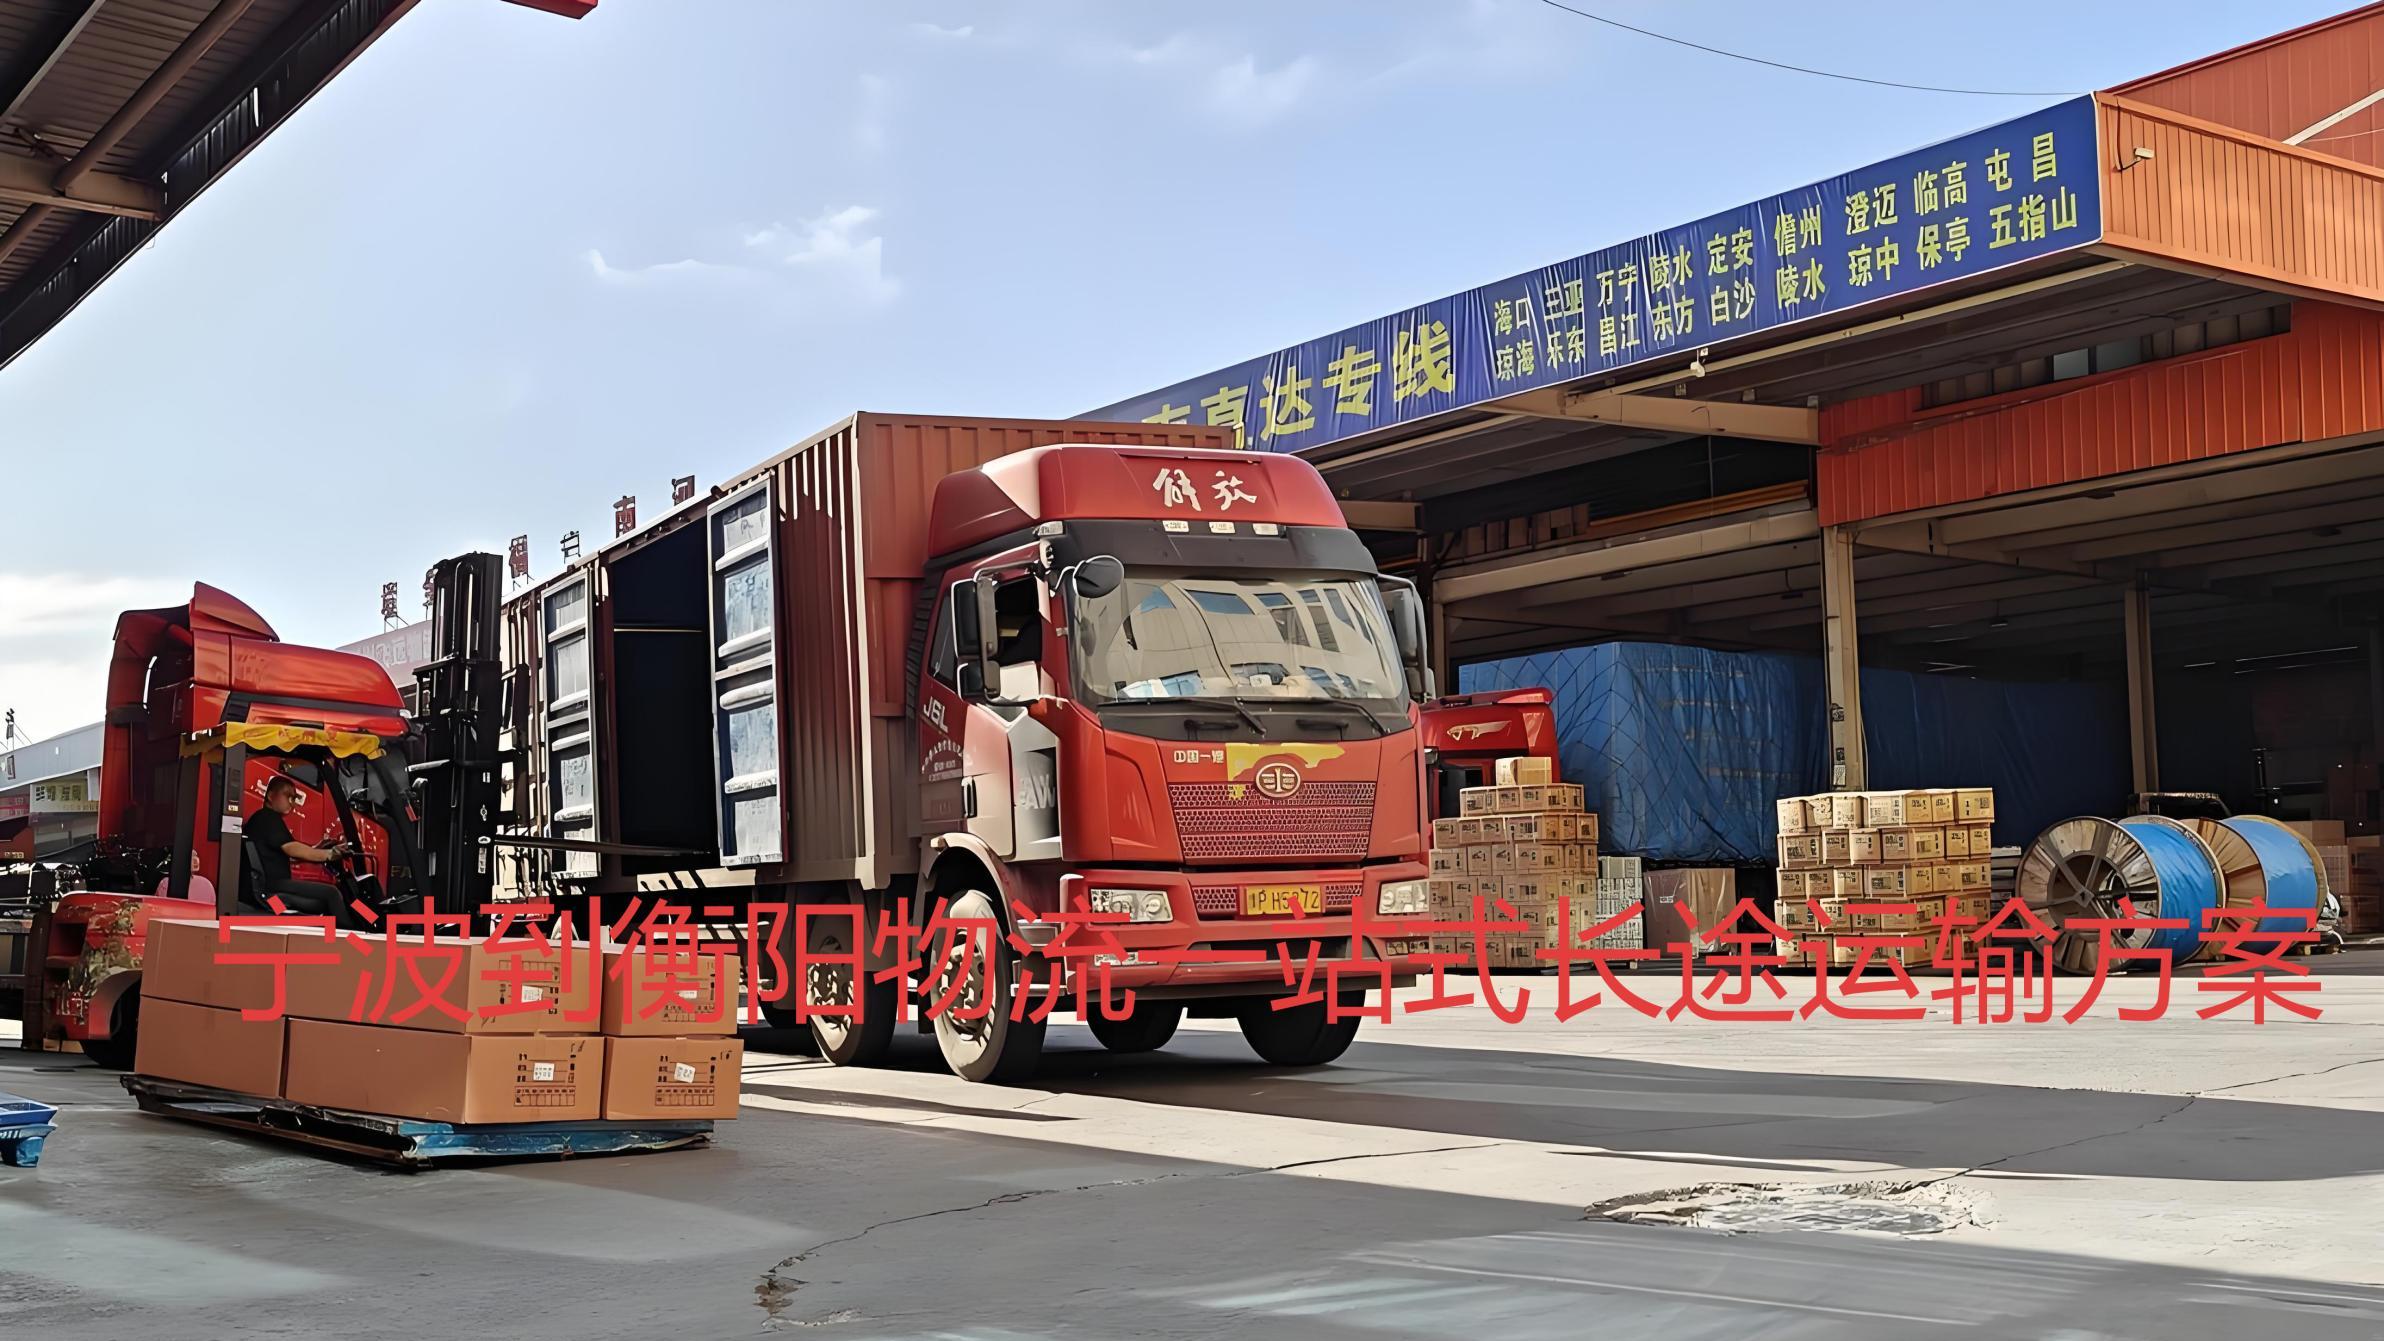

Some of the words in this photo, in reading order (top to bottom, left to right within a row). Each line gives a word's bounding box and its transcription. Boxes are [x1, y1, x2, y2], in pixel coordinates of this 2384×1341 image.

[1494, 297, 1531, 336] 海口
[1544, 278, 1583, 320] 三亚
[1597, 262, 1637, 307] 万宁
[1650, 245, 1693, 293] 陵水
[1708, 227, 1755, 276] 定安
[1774, 204, 1822, 257] 儋州
[1845, 183, 1899, 236] 澄迈
[1914, 161, 1968, 216] 临高
[1497, 339, 1535, 381] 琼海
[1600, 313, 1640, 357] 昌江
[1654, 295, 1695, 341] 东方
[1711, 277, 1756, 327] 白沙
[1776, 258, 1825, 310] 陵水
[1848, 236, 1900, 288] 琼中
[1916, 217, 1971, 271] 保亭
[1989, 186, 2078, 249] 五指山
[1152, 468, 1257, 511] 解放
